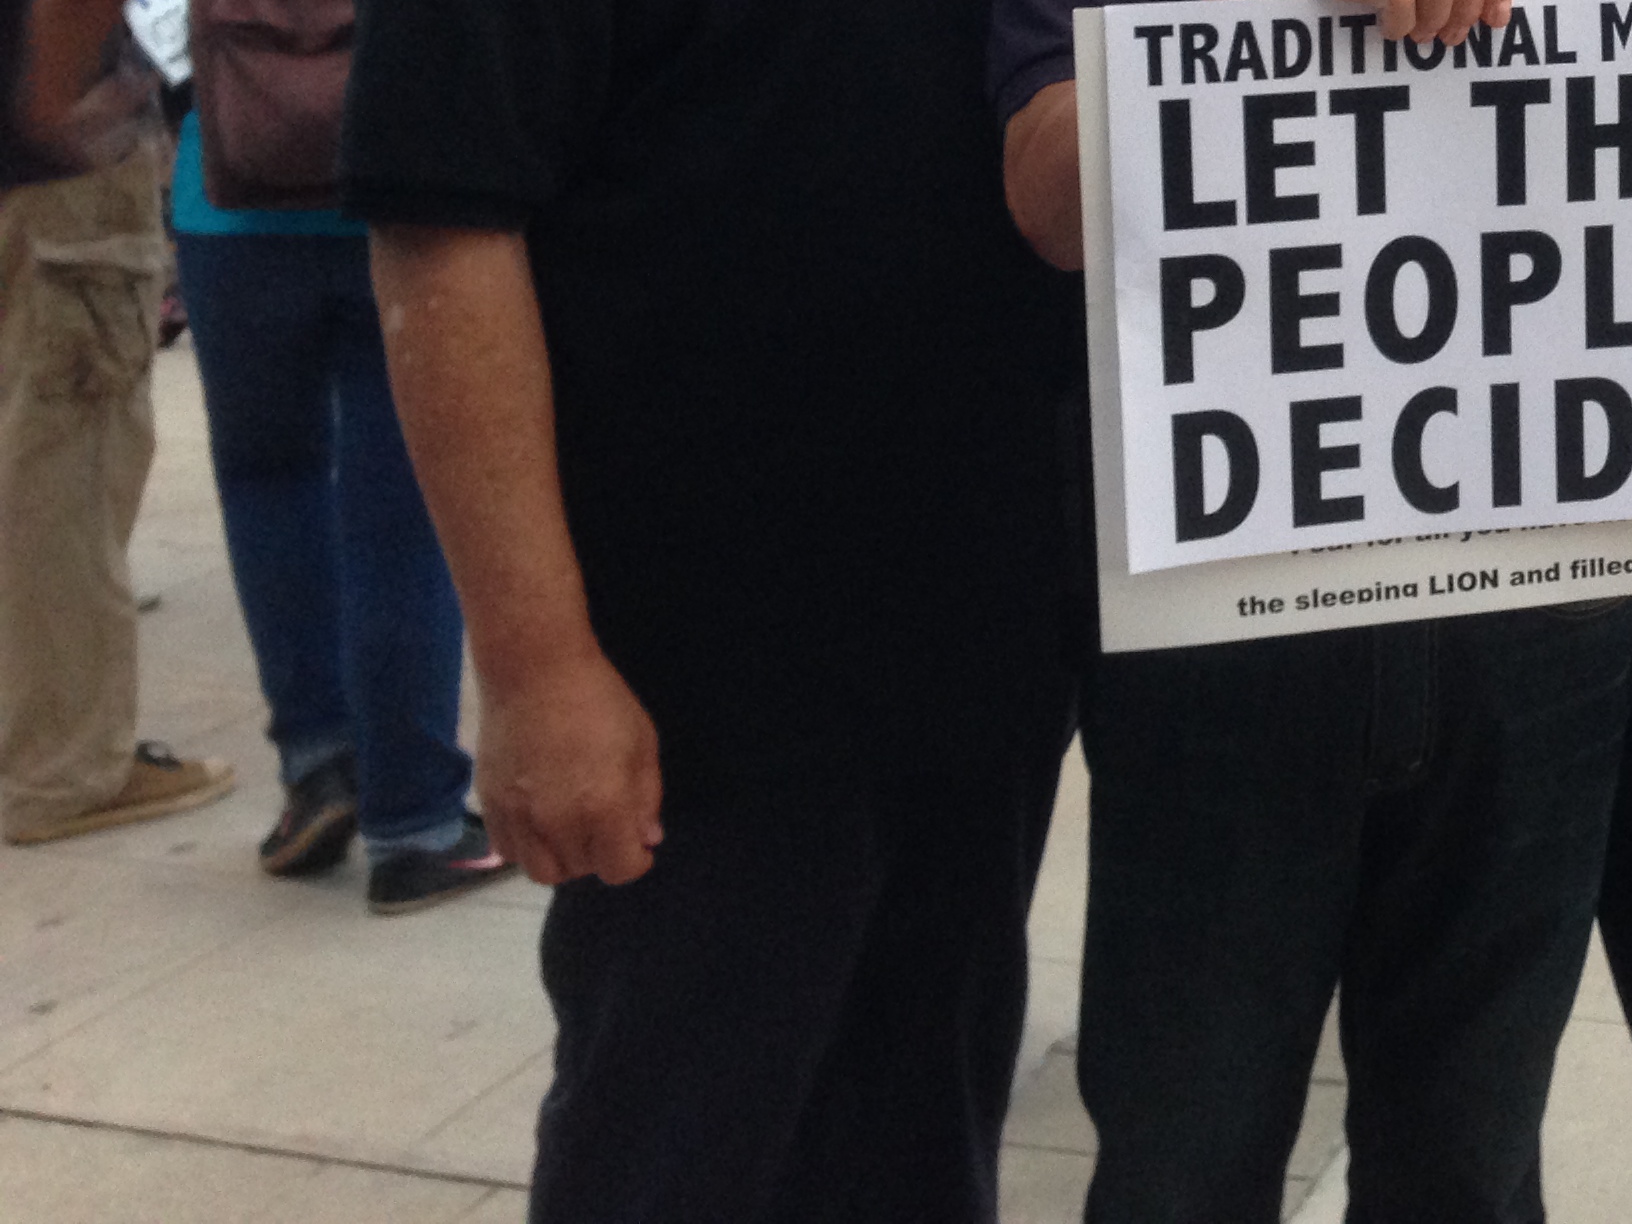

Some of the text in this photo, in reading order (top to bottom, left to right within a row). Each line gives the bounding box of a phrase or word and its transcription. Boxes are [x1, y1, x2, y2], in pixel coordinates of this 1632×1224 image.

[1158, 84, 1411, 232] LET
[1237, 595, 1285, 616] the
[1429, 569, 1499, 596] LION
[1510, 563, 1560, 587] and
